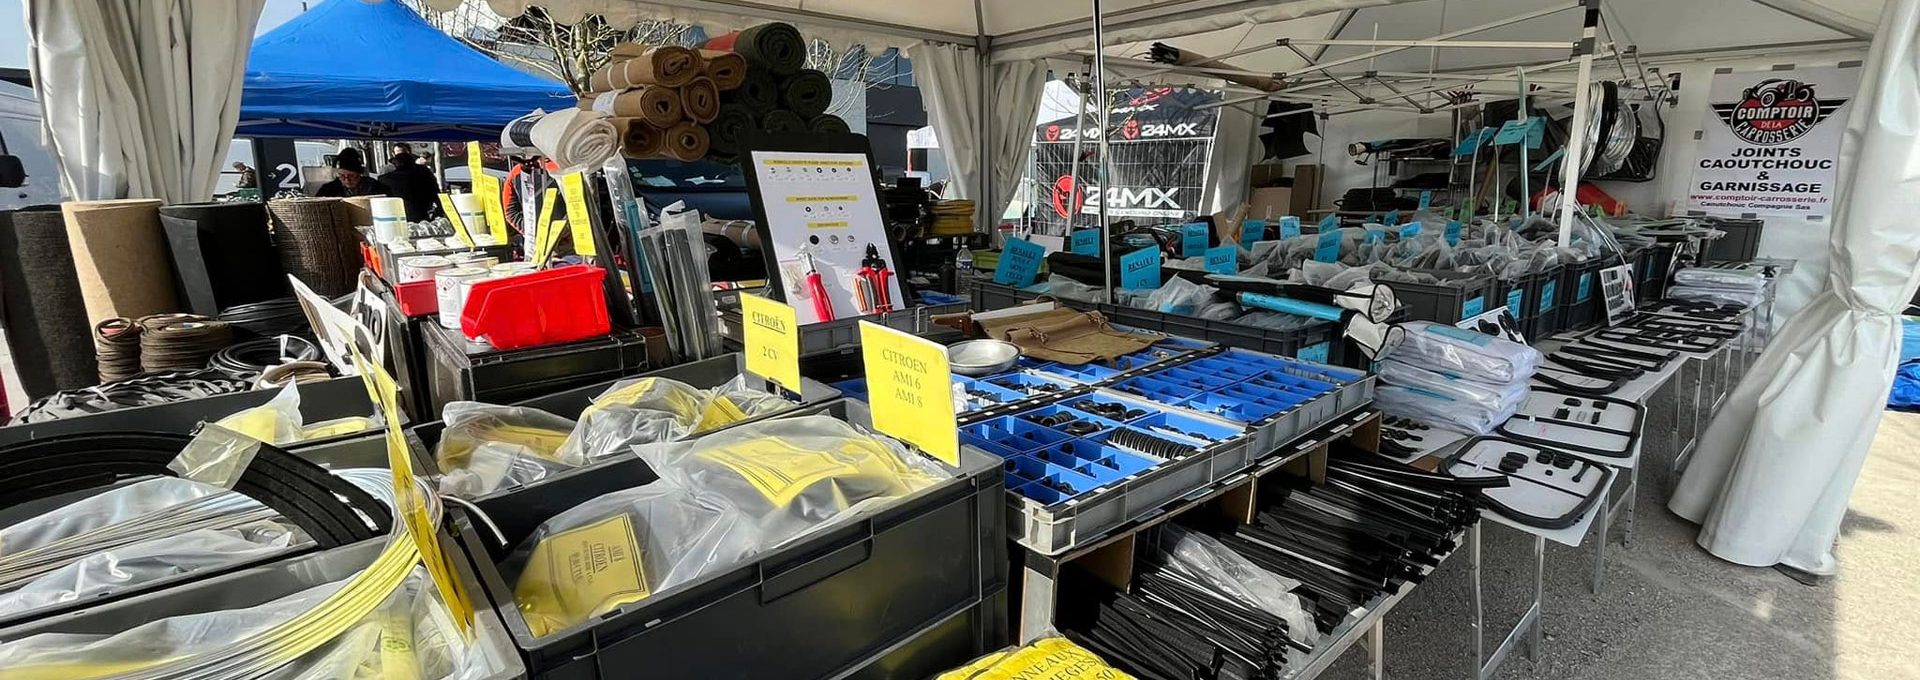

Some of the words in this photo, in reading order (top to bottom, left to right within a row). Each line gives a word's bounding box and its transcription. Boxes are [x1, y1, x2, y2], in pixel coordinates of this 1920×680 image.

[1737, 106, 1813, 119] COMPTOIR
[1141, 123, 1197, 136] 24MX
[1735, 118, 1811, 143] CARROSSERIE
[1731, 147, 1802, 157] JOINTS
[1700, 159, 1833, 170] CAOUTCHOUC
[276, 163, 300, 188] 2
[1757, 171, 1769, 180] &
[1700, 181, 1822, 193] GARNISSAGE
[1085, 187, 1180, 208] 24MX
[1690, 194, 1828, 203] www.comptoir-carrosserie.fr
[893, 370, 912, 387] AMI
[915, 378, 921, 390] 6
[896, 387, 914, 405] AMI
[917, 396, 923, 408] 8
